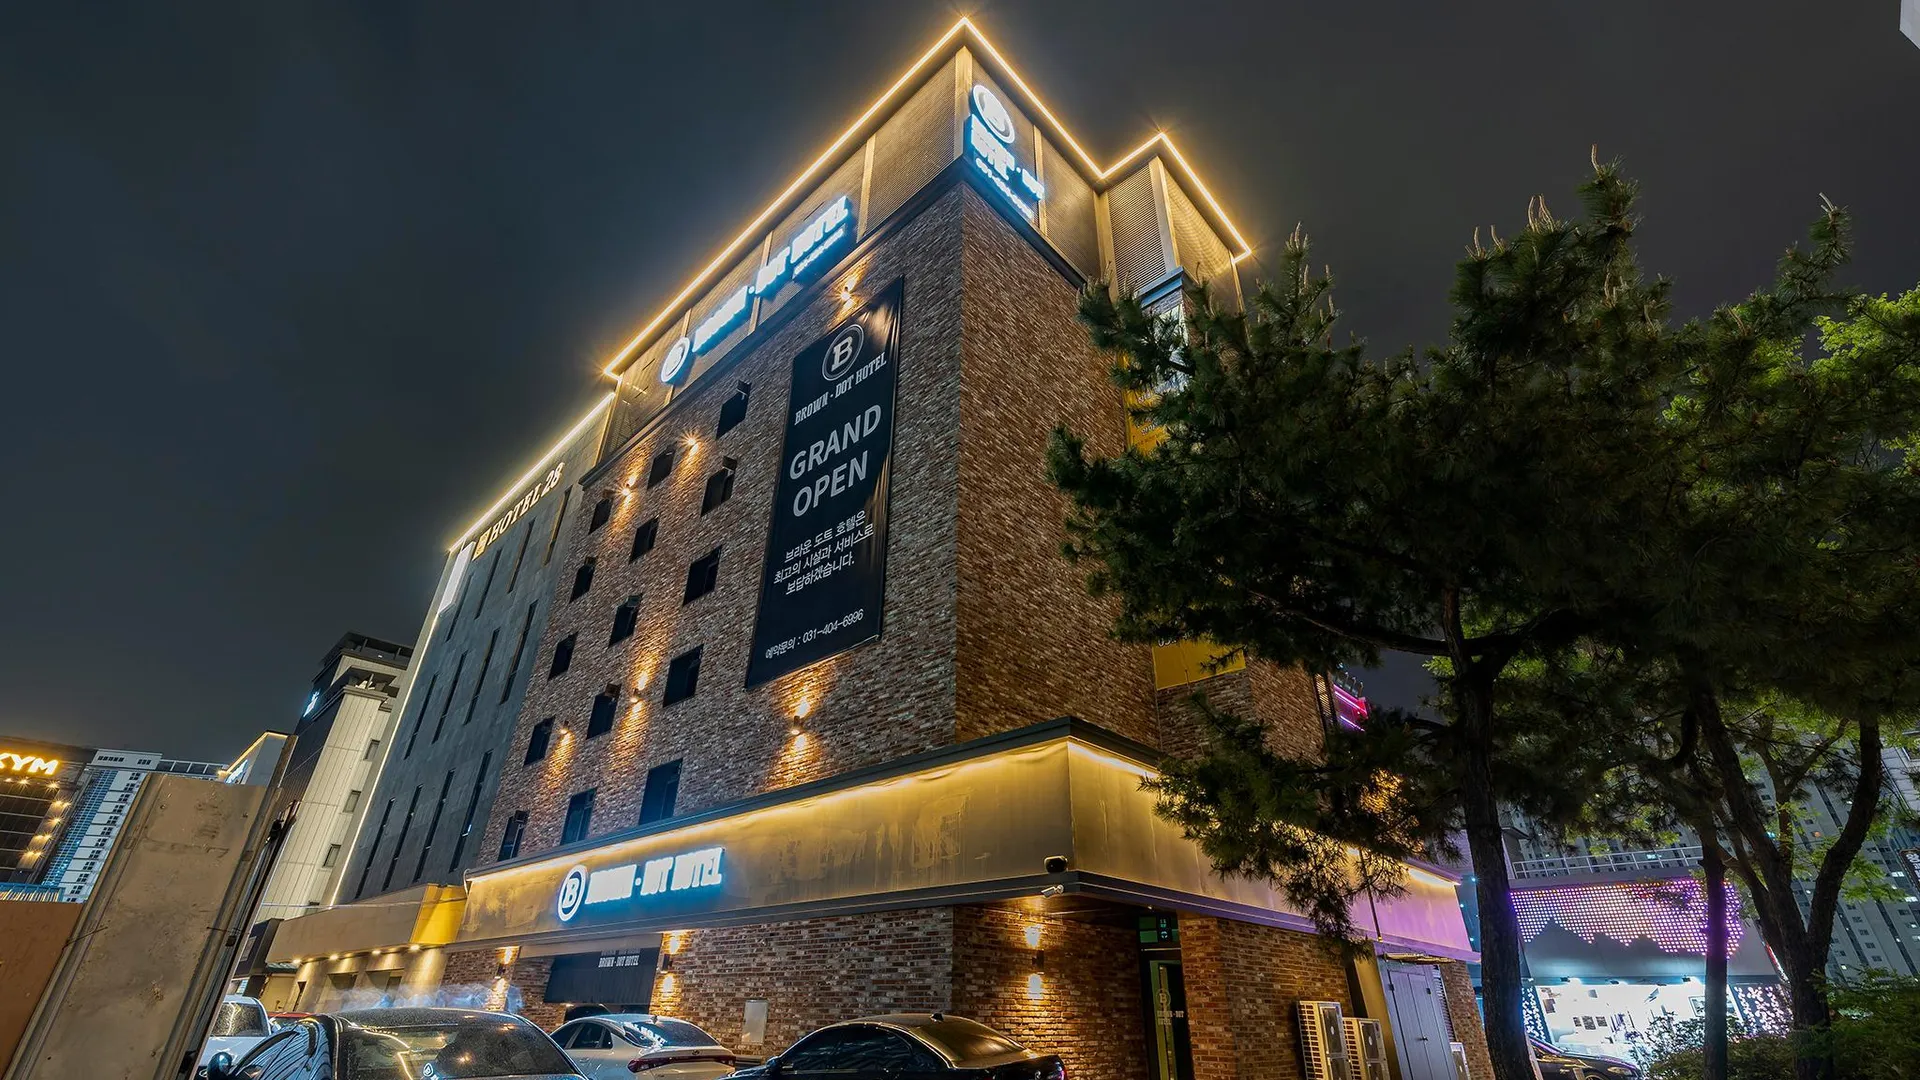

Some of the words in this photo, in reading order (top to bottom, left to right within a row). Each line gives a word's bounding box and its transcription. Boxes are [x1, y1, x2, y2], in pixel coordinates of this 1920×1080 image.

[831, 336, 853, 372] B
[794, 397, 828, 426] BROWN
[835, 376, 854, 398] DOT
[855, 352, 887, 385] HOTEL
[789, 404, 881, 480] GRAND
[487, 483, 542, 546] HOTEL
[541, 462, 565, 497] 28
[793, 451, 868, 517] OPEN
[773, 560, 802, 584] 최고의
[803, 544, 832, 569] 시설과
[833, 523, 874, 554] 서비스로
[784, 538, 812, 563] 브라운
[813, 528, 833, 548] 도트
[835, 509, 866, 537] 호텔은
[785, 551, 855, 595] 보답하겠습니다.
